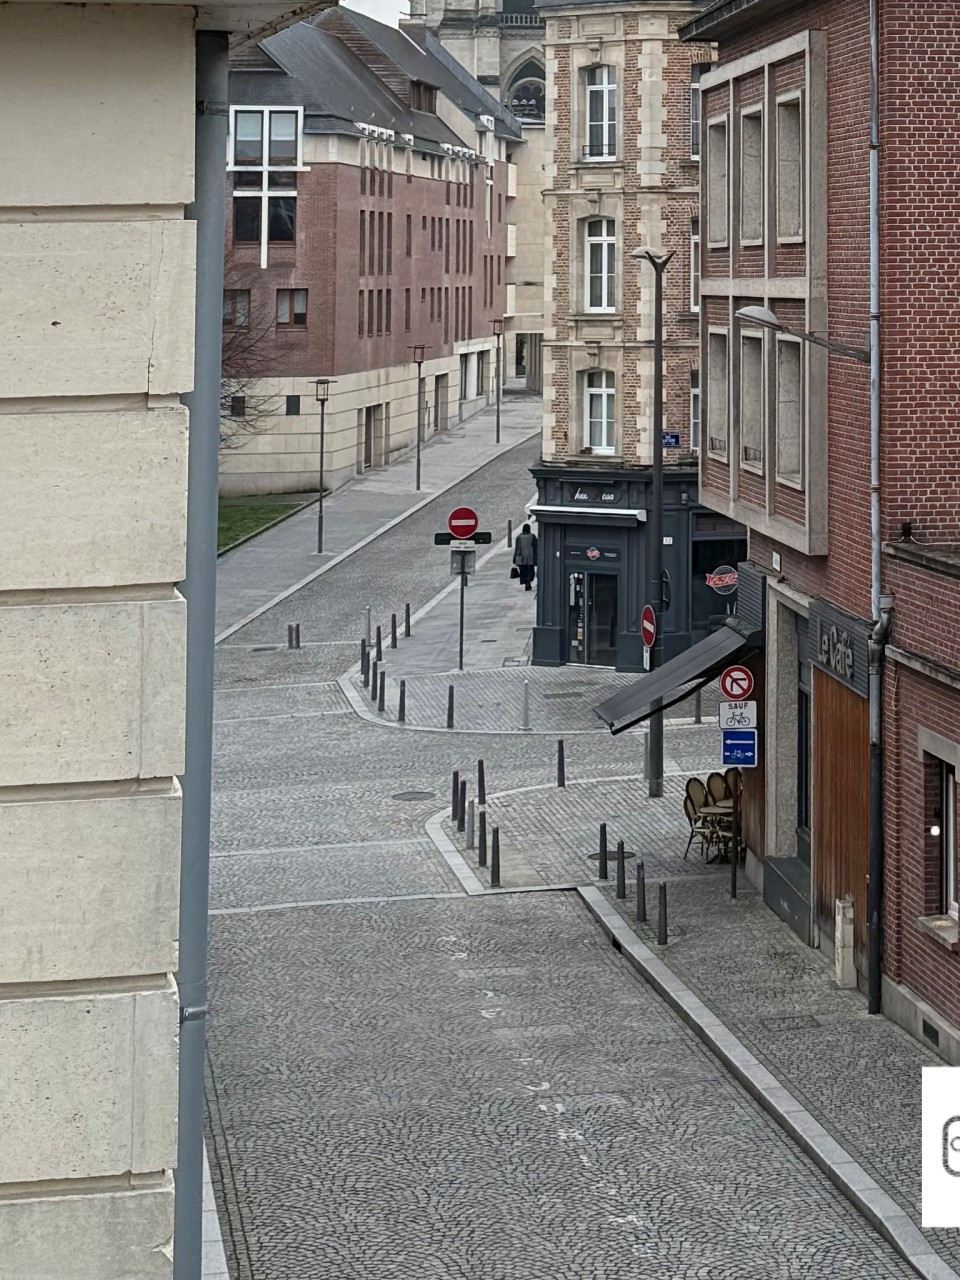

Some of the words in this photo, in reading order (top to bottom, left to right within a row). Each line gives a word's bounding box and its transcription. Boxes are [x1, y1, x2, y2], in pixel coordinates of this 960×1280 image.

[816, 617, 829, 663] Le
[830, 625, 853, 679] Café
[728, 702, 749, 710] SAUF
